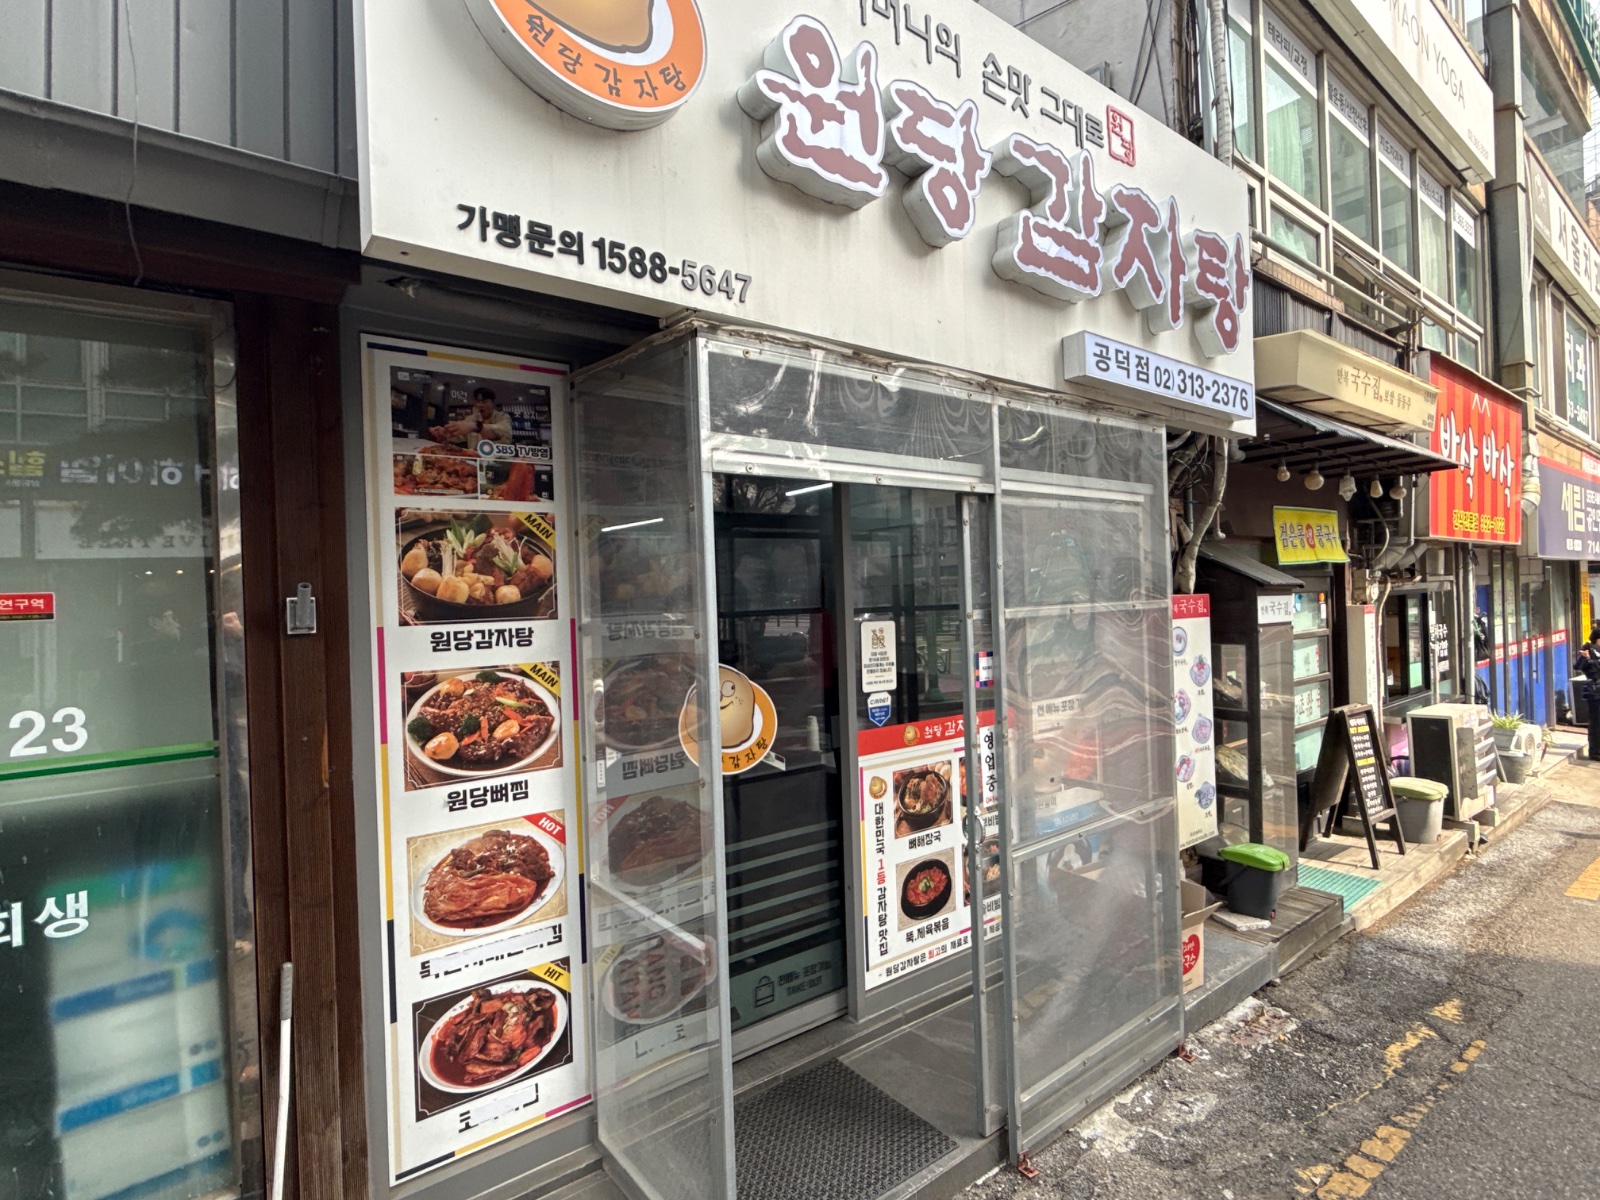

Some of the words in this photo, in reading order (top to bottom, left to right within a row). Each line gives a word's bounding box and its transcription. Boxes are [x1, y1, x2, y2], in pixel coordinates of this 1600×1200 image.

[526, 12, 687, 100] 원당감자탕
[1433, 43, 1466, 109] YOGA
[982, 52, 1031, 119] 손맛
[1040, 86, 1105, 149] 그대로
[457, 203, 585, 265] 가맹문의
[592, 236, 752, 303] 1588-5647
[1007, 133, 1252, 354] 감자탕
[1093, 341, 1151, 384] 공덕점
[495, 444, 515, 455] SBS
[1482, 426, 1515, 509] 바삭
[523, 513, 553, 540] MAIN
[430, 627, 534, 652] 원당감자탕
[529, 663, 559, 689] MAIN
[8, 706, 89, 758] 23
[923, 724, 943, 739] 원당
[722, 737, 768, 769] 감자탕
[983, 731, 998, 792] 영업중
[445, 778, 530, 813] 원당뼈찜
[538, 816, 563, 837] HOT
[874, 802, 886, 855] 대한민국
[908, 829, 942, 850] 뼈해장국
[876, 858, 886, 885] 1등
[877, 886, 888, 928] 감자탕
[878, 928, 889, 956] 맛집
[885, 952, 927, 977] 원당감자탕은
[927, 943, 948, 960] 최고의
[950, 935, 969, 950] 재료로
[543, 966, 564, 982] HIT
